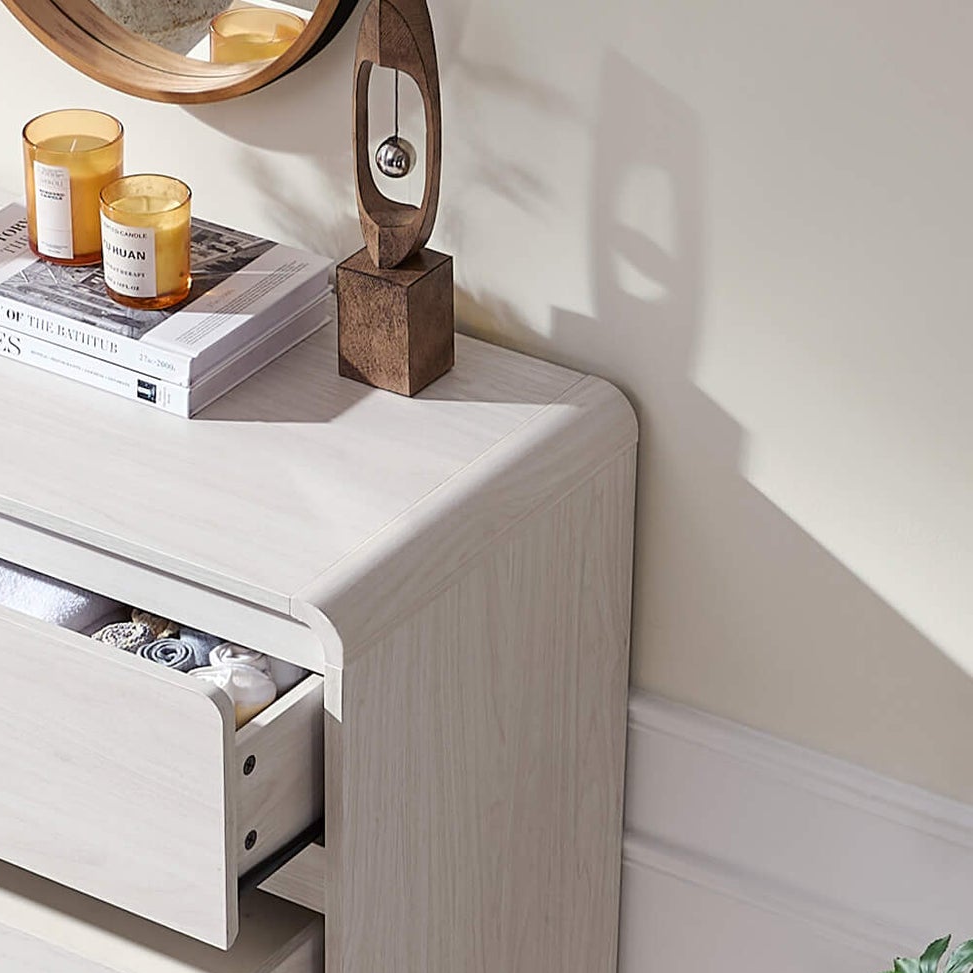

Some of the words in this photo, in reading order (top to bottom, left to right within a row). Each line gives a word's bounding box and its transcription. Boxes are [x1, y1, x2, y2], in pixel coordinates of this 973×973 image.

[112, 245, 146, 261] HUAN
[6, 308, 24, 323] OF
[27, 314, 54, 334] THE
[57, 324, 118, 354] BATHTUB
